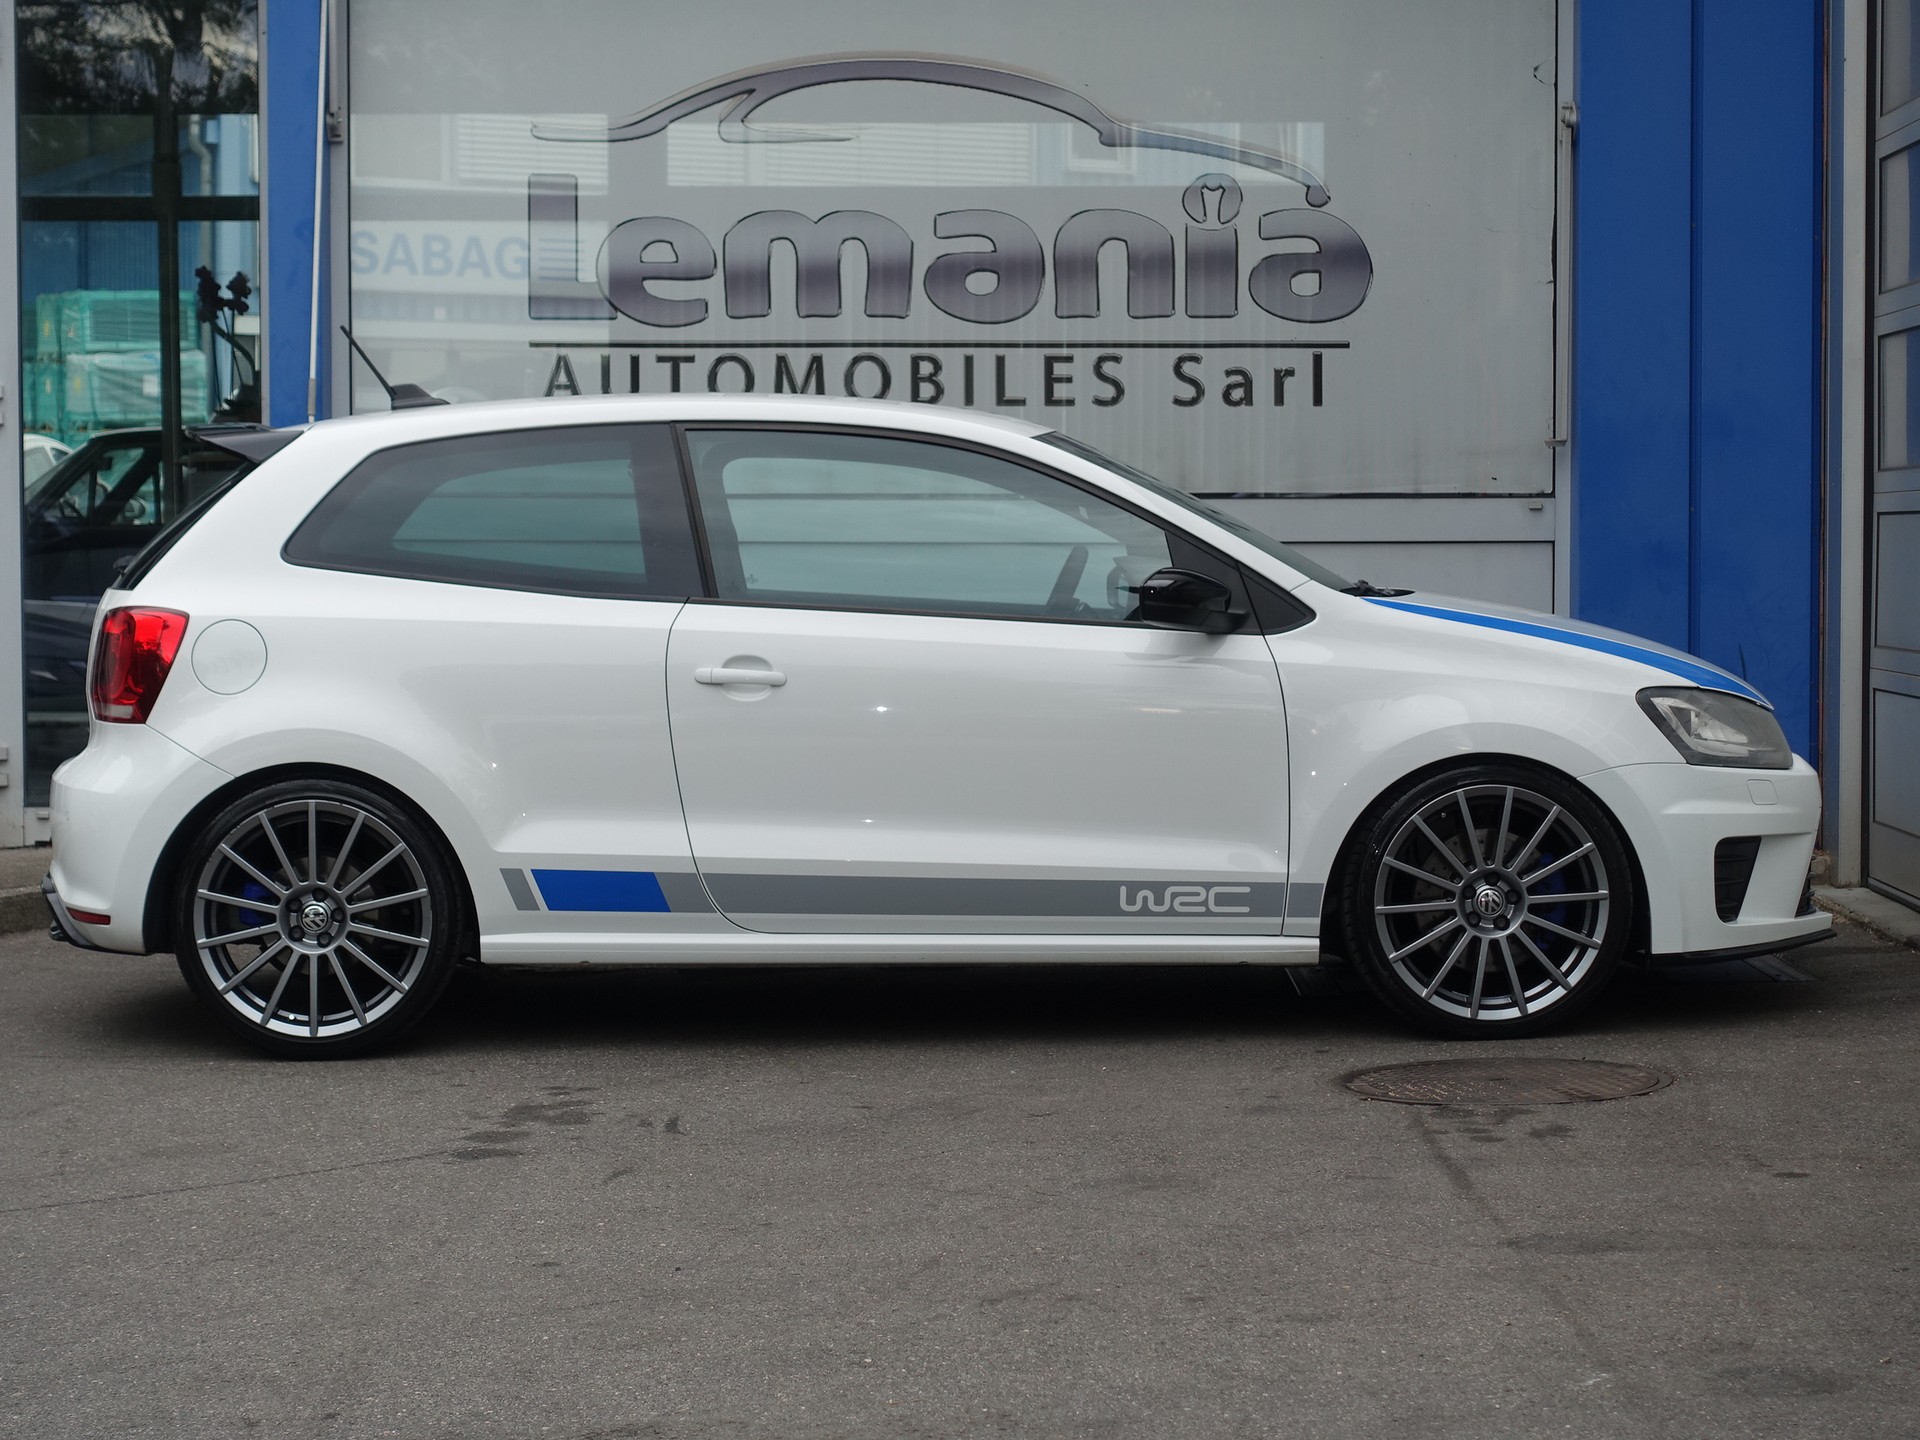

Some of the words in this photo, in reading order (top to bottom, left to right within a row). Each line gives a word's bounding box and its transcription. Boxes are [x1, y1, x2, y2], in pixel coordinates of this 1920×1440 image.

[352, 230, 529, 280] SABAG
[528, 172, 1374, 327] Lemania
[544, 352, 1126, 407] AUTOMOBILES
[1171, 350, 1324, 407] Sarl
[1119, 885, 1251, 913] WRC
